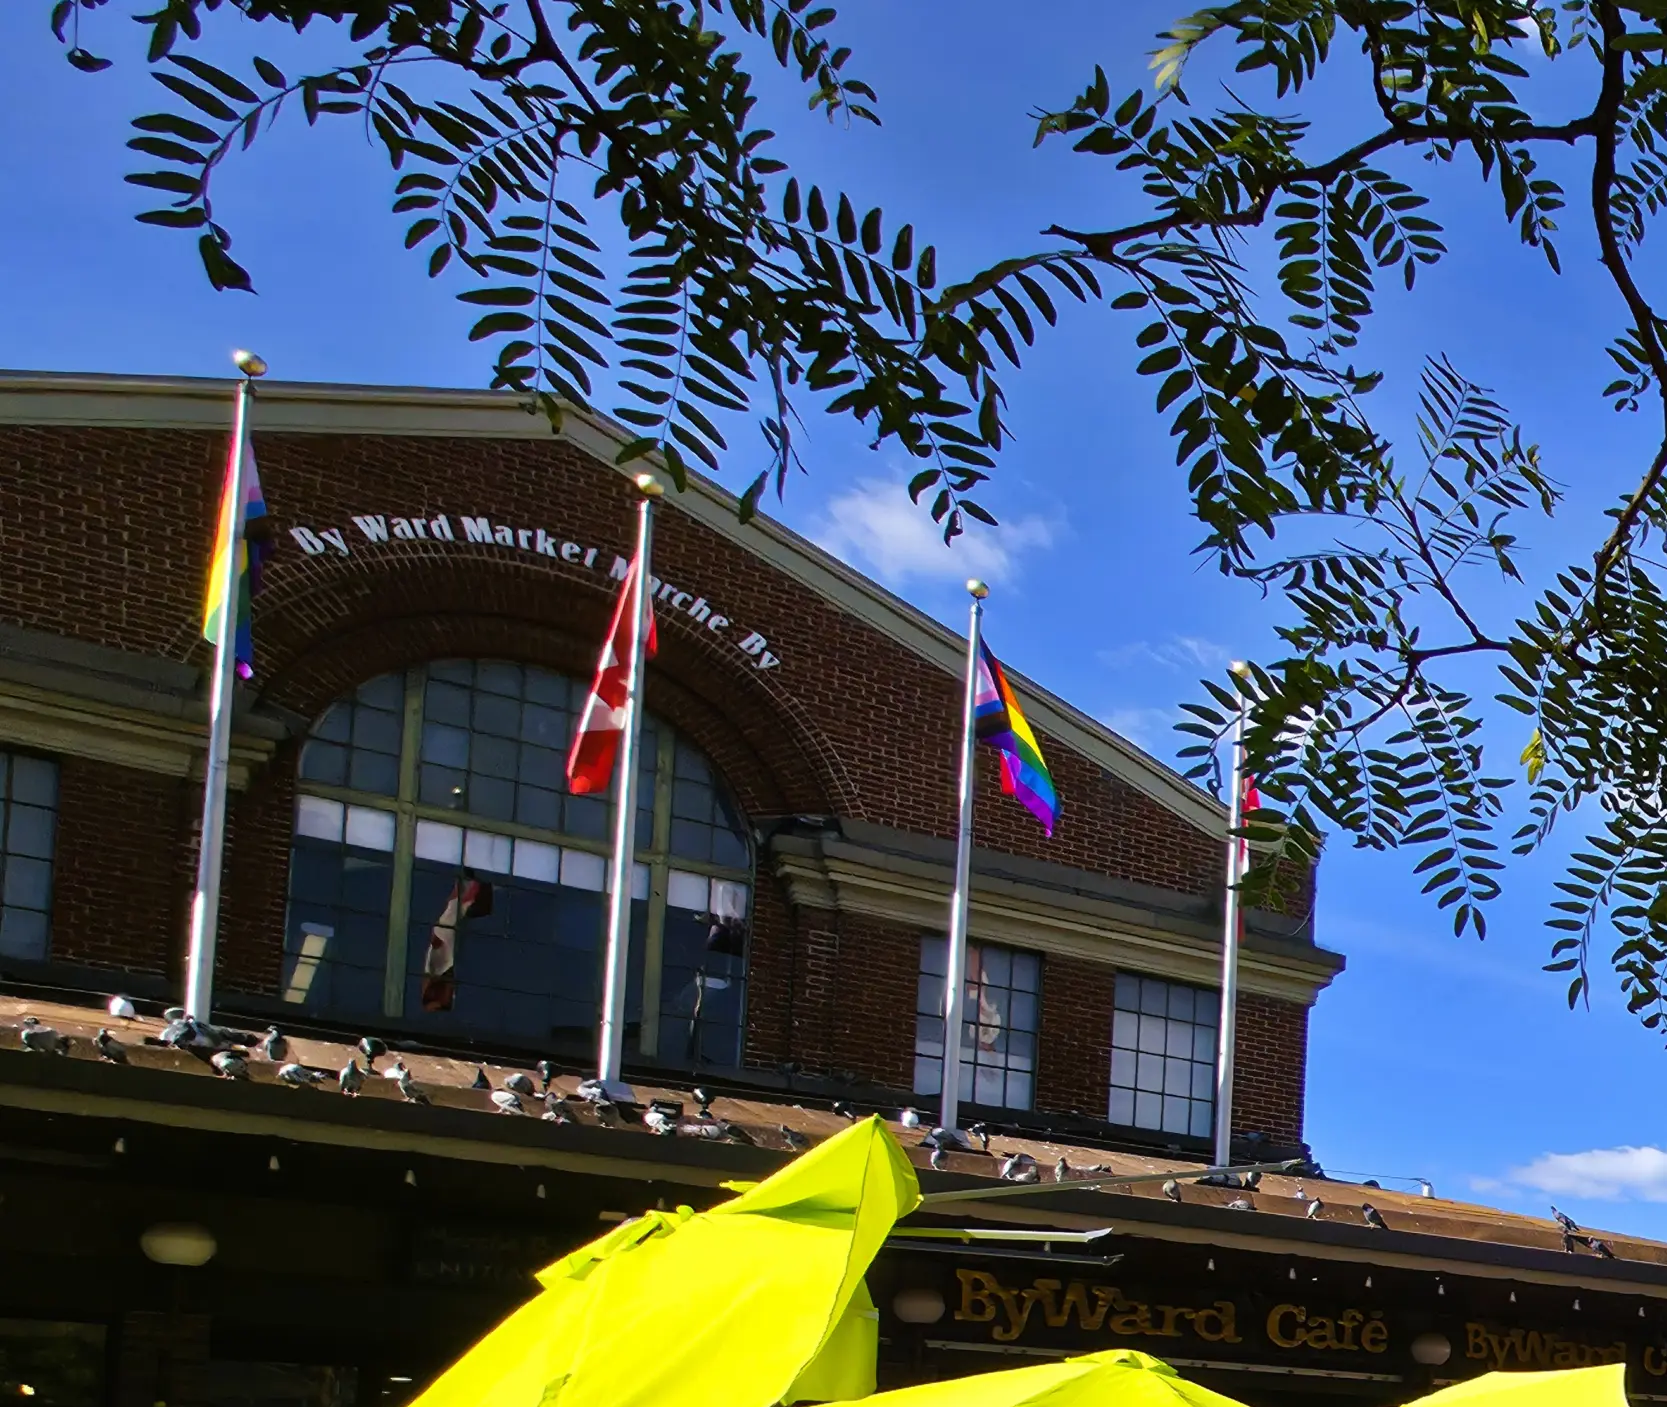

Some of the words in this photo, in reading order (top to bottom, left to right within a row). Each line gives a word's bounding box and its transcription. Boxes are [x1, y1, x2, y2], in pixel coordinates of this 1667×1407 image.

[289, 526, 350, 556] By
[352, 514, 455, 542] Ward
[461, 516, 600, 569] Market
[739, 631, 781, 669] By
[954, 1268, 1243, 1343] ByWard
[1266, 1302, 1388, 1353] Café
